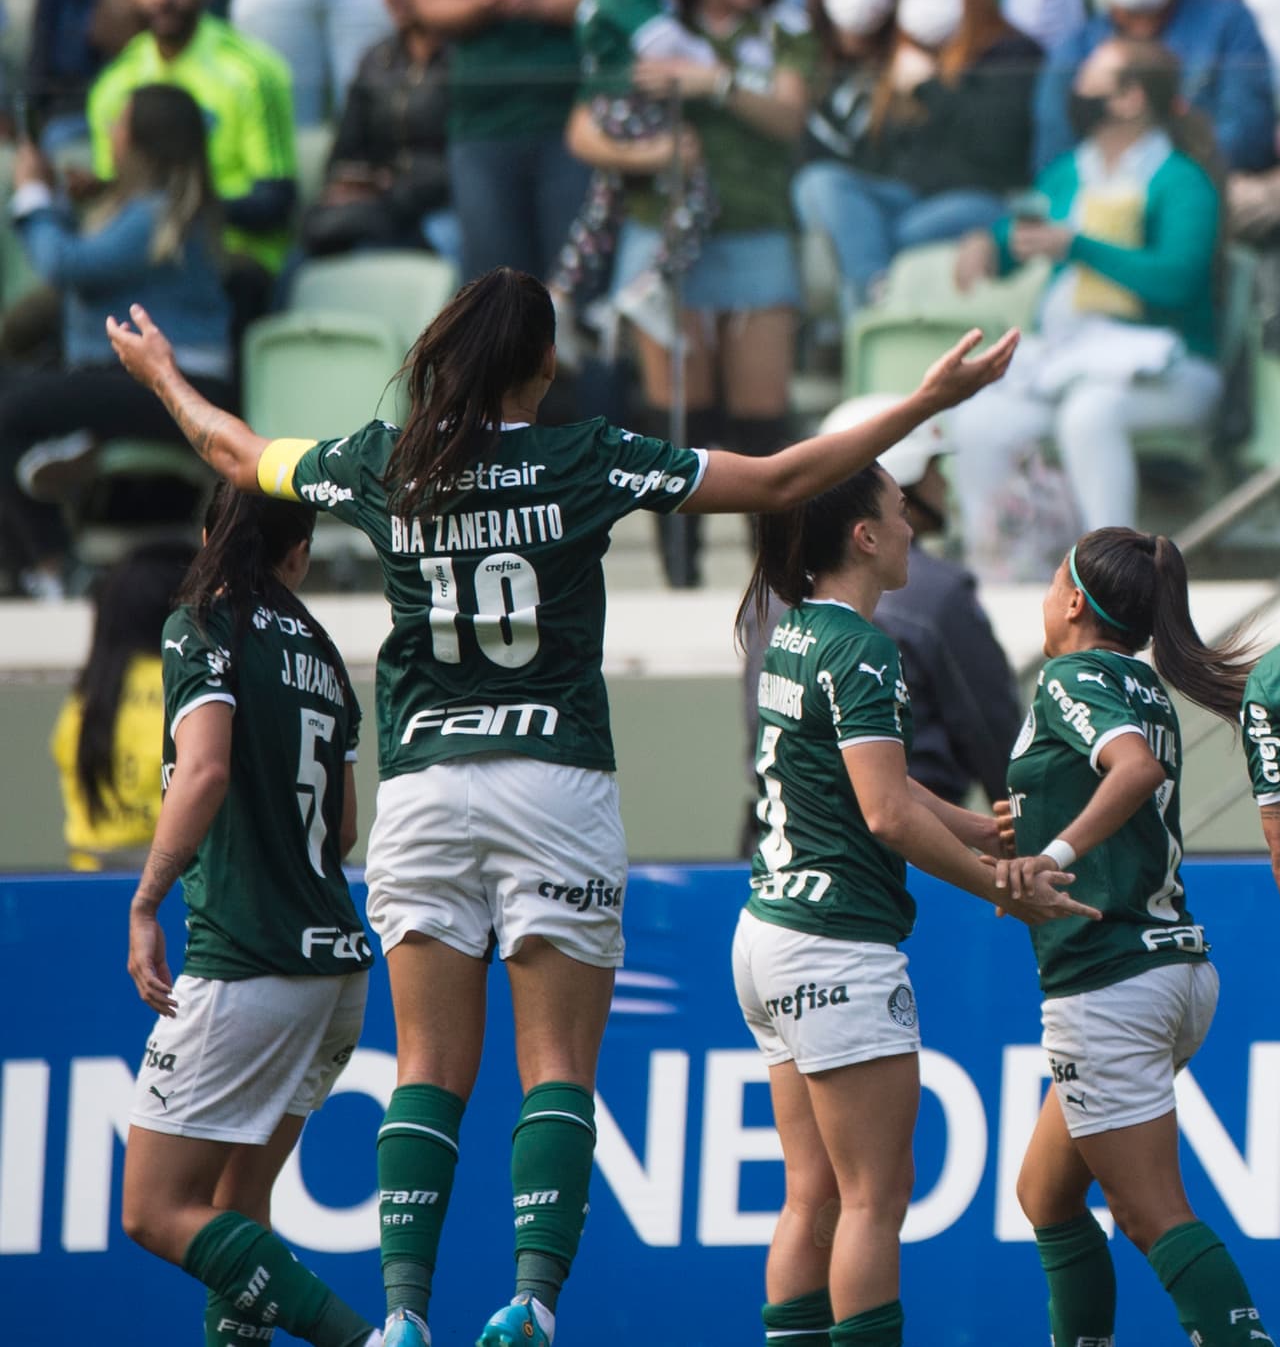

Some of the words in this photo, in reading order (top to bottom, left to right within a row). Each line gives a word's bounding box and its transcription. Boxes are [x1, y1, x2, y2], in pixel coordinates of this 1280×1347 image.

[458, 461, 546, 492] etfair
[391, 515, 425, 553] BIA
[433, 503, 565, 551] ZANERATTO
[485, 560, 521, 573] crefisa
[419, 552, 540, 669] 10
[297, 707, 337, 879] 5
[537, 879, 622, 912] crefisa
